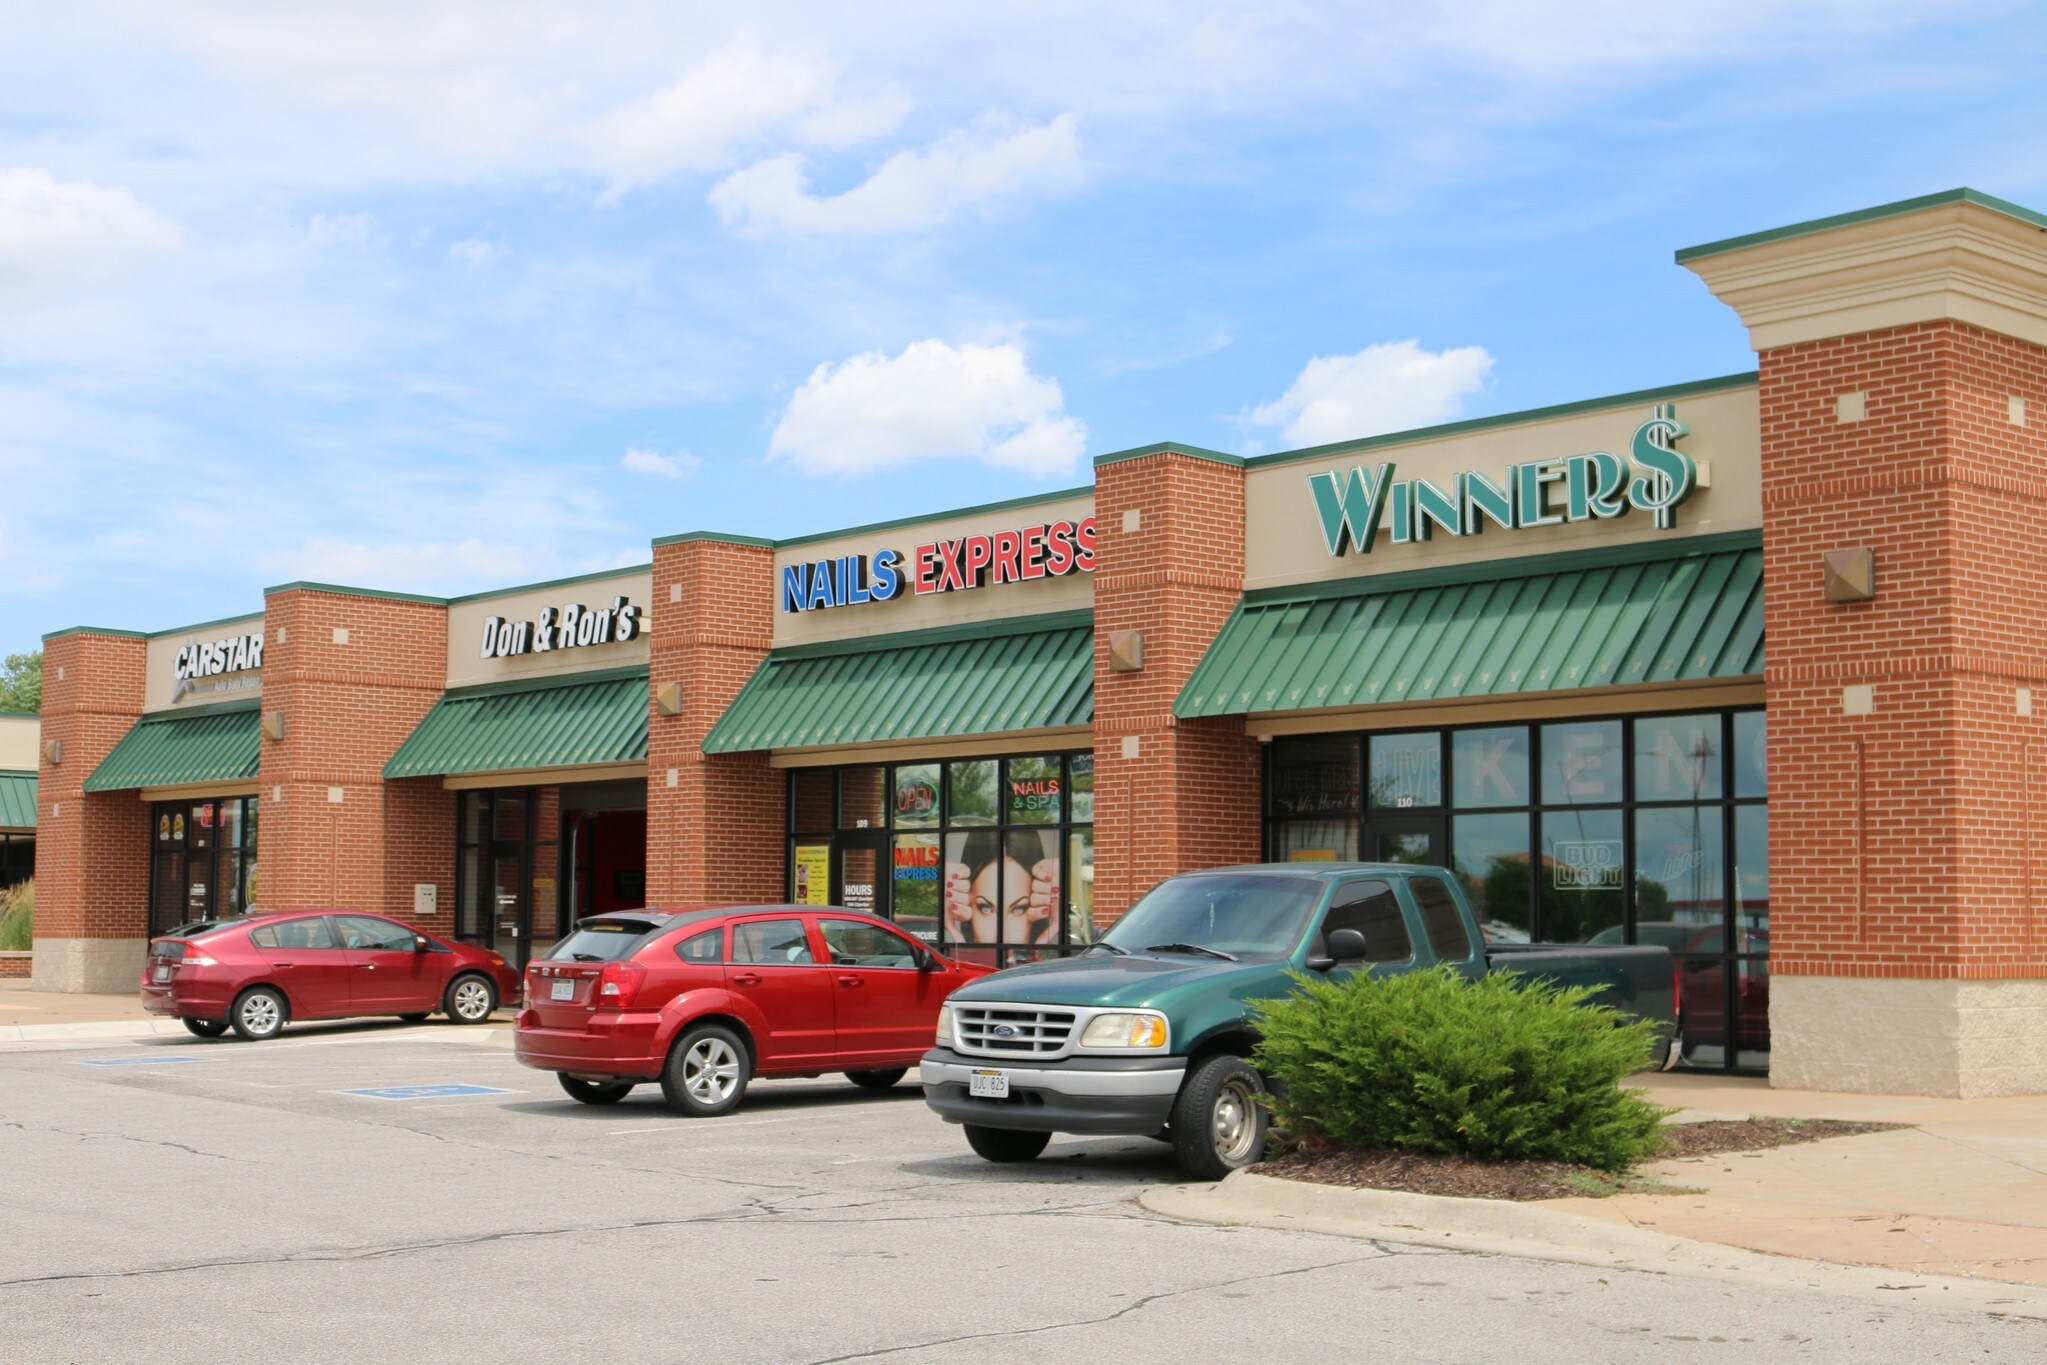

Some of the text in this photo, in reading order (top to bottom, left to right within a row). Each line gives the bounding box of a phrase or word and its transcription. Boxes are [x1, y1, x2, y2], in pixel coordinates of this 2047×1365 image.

[783, 516, 1094, 613] NAILS EXPRESS
[480, 596, 641, 659] Don & Ron's
[174, 633, 264, 680] CARSTAR
[1014, 779, 1060, 796] NAILS
[898, 787, 932, 811] OPEN
[1014, 795, 1060, 810] & SPA
[1397, 797, 1413, 808] 110
[856, 819, 868, 829] 109
[893, 846, 939, 867] NAILS
[1565, 845, 1612, 866] BUD
[893, 867, 938, 881] EXPRESS
[1557, 864, 1621, 886] LIGHT
[845, 884, 873, 896] HOURS
[990, 1077, 1005, 1091] 825
